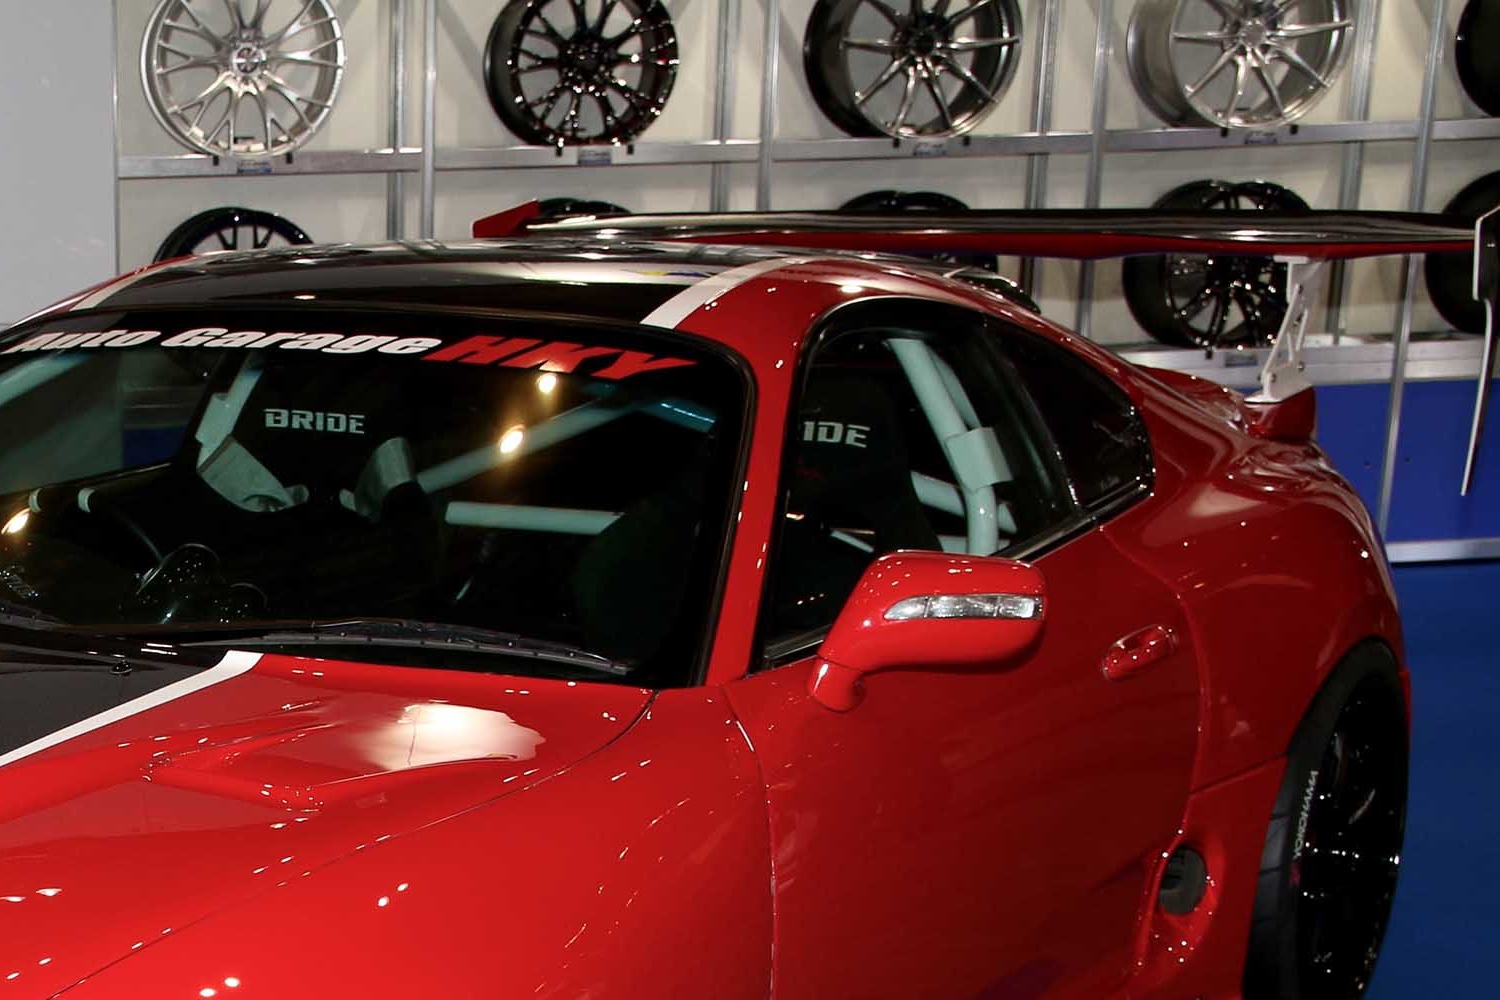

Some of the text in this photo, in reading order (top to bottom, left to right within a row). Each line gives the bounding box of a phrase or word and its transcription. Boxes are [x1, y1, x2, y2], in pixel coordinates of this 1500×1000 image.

[0, 327, 698, 380] Auto Garage HKY
[263, 408, 365, 434] BRIDE
[803, 421, 871, 448] IDE
